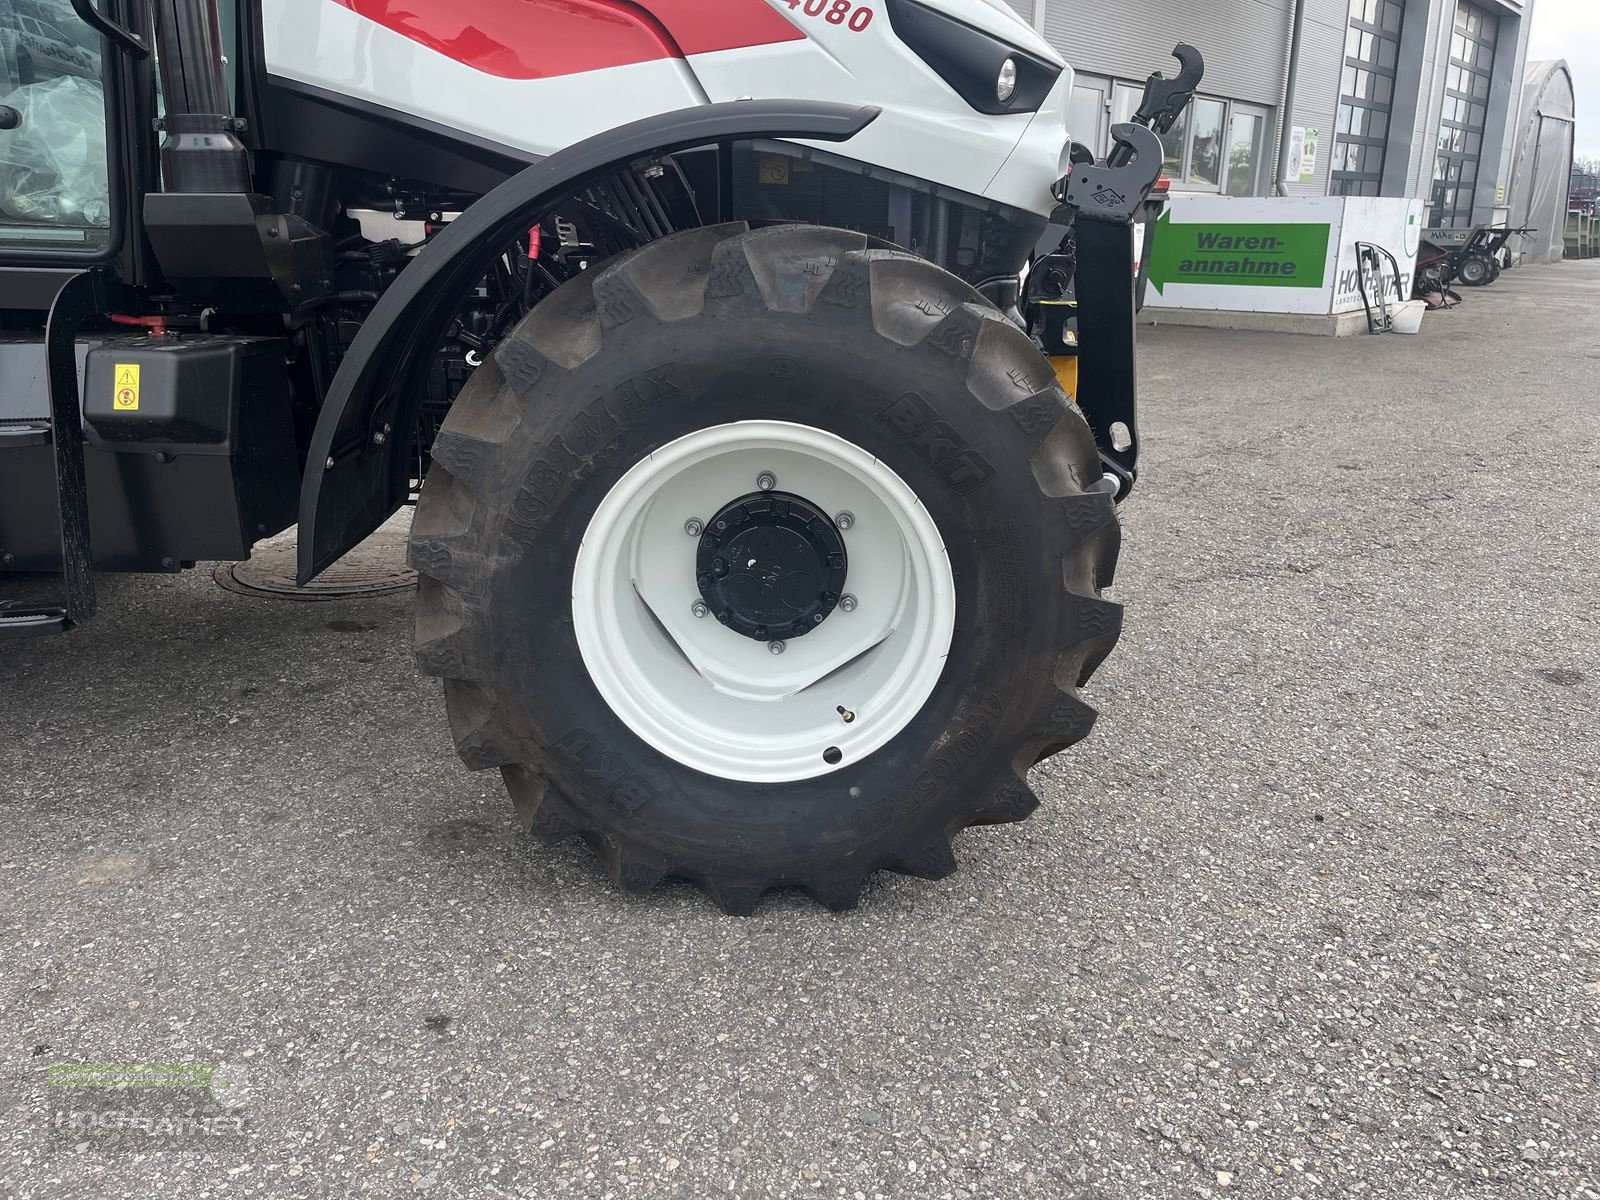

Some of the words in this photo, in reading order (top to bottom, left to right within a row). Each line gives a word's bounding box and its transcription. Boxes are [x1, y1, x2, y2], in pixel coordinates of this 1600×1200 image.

[1196, 232, 1284, 250] Waren-
[1178, 257, 1297, 275] annahme
[1337, 268, 1410, 295] HOHTHR
[876, 392, 995, 492] BKT
[549, 731, 657, 815] BKT
